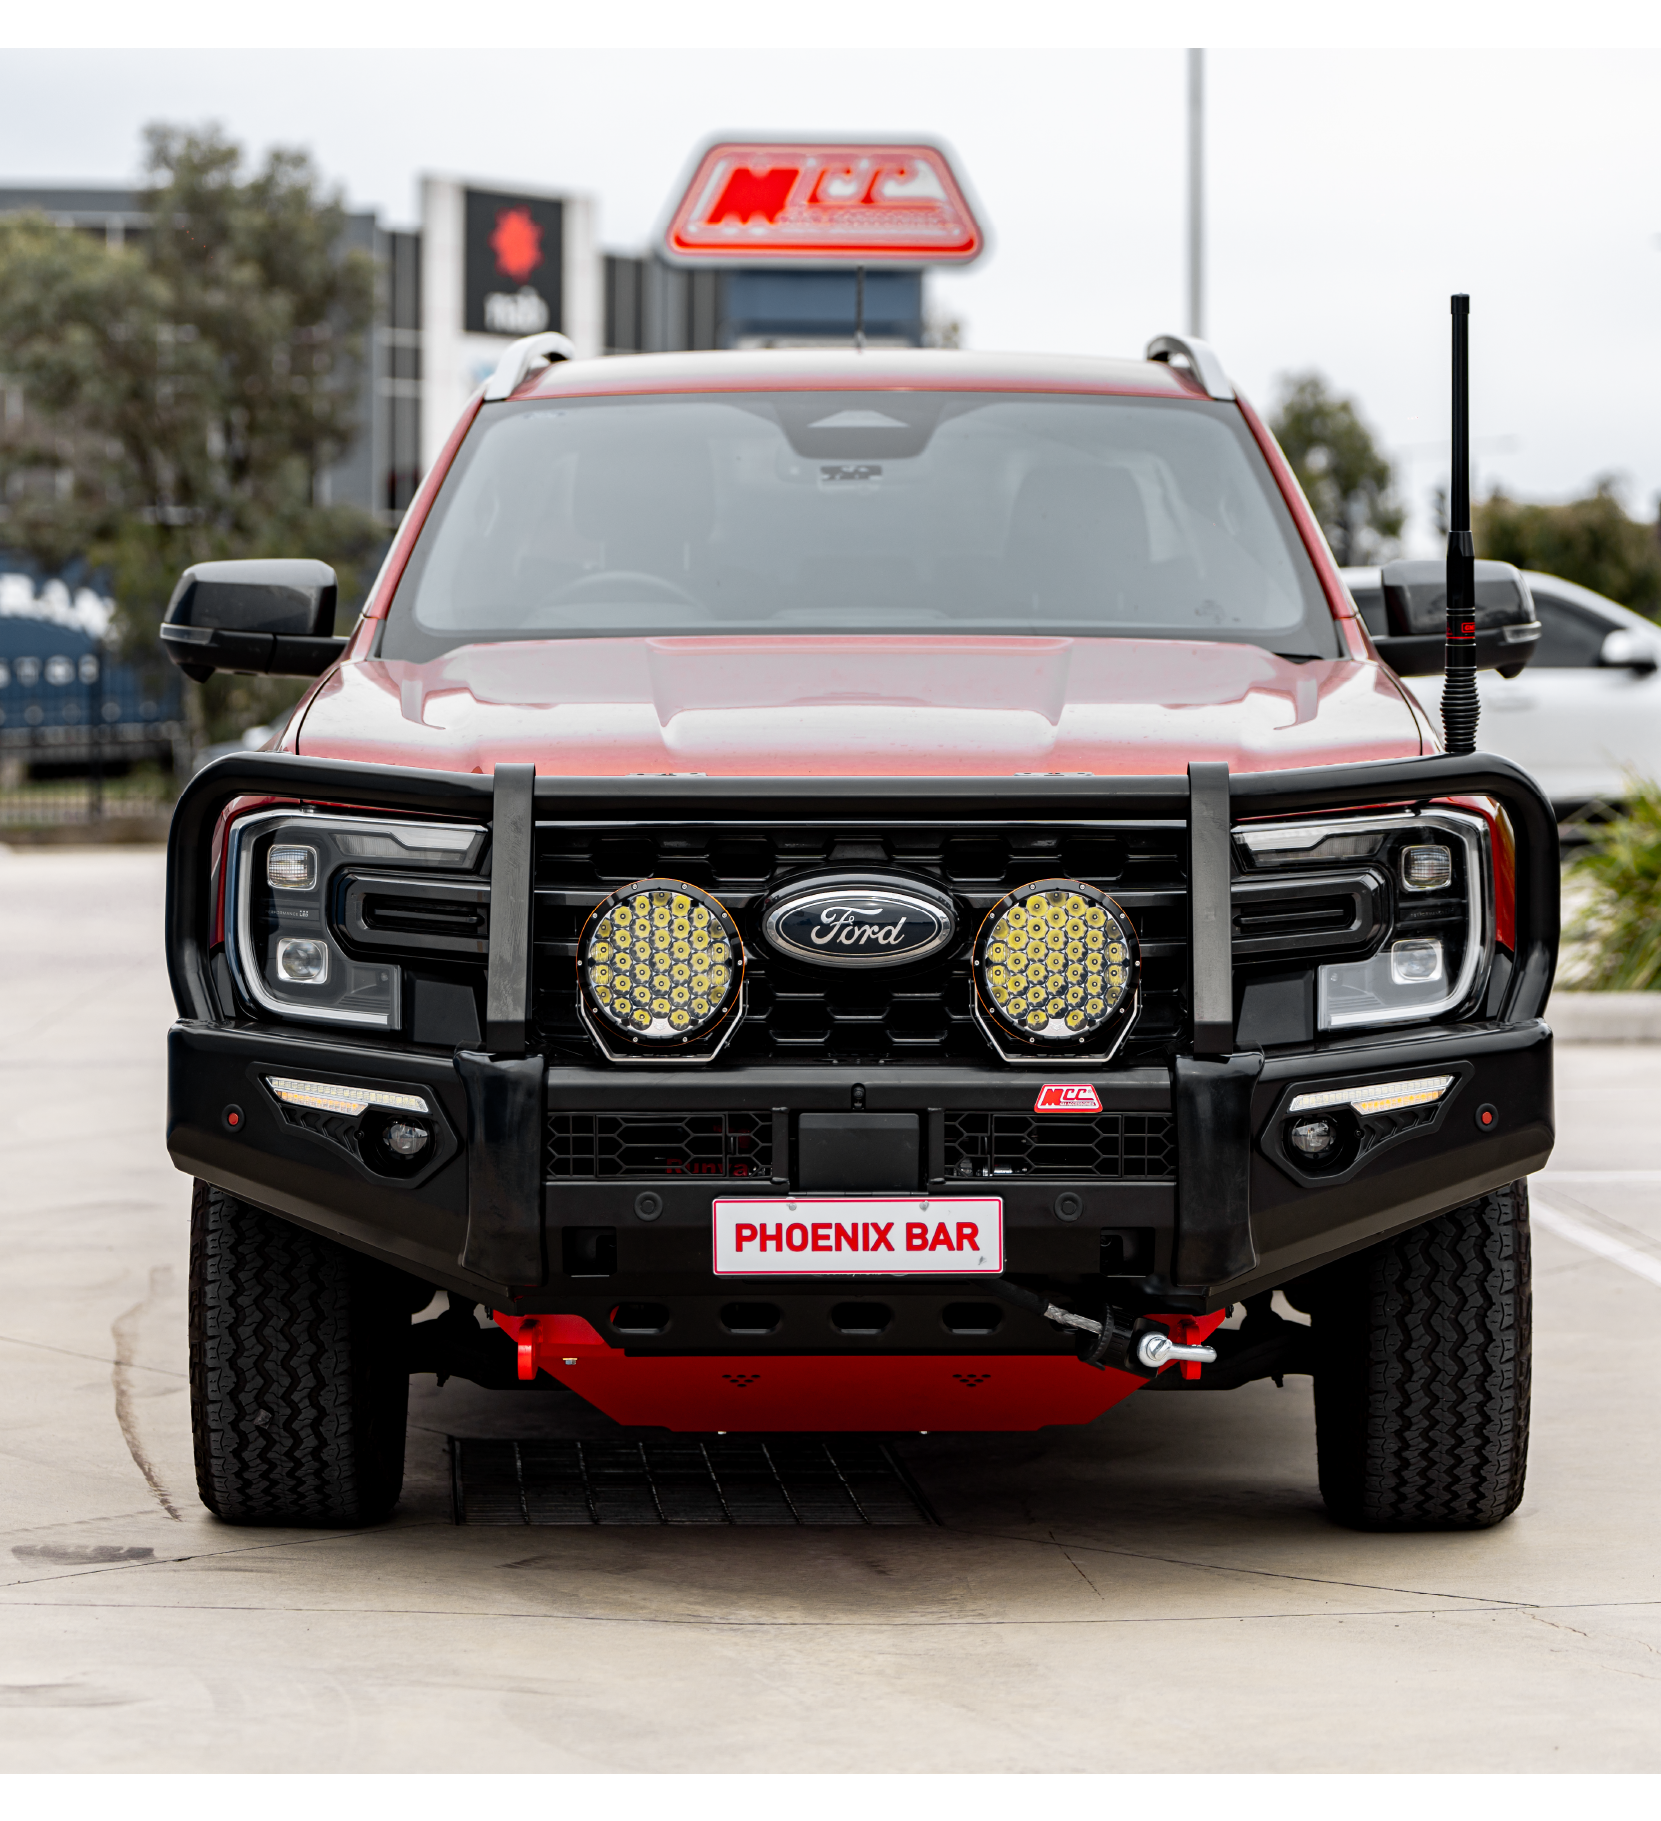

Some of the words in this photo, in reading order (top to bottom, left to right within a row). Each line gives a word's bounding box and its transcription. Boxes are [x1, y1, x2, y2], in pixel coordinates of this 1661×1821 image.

[706, 167, 942, 225] MCC
[811, 906, 907, 945] Ford
[1041, 1088, 1095, 1106] MCC
[735, 1222, 895, 1252] PHOENIX
[906, 1222, 980, 1252] BAR
